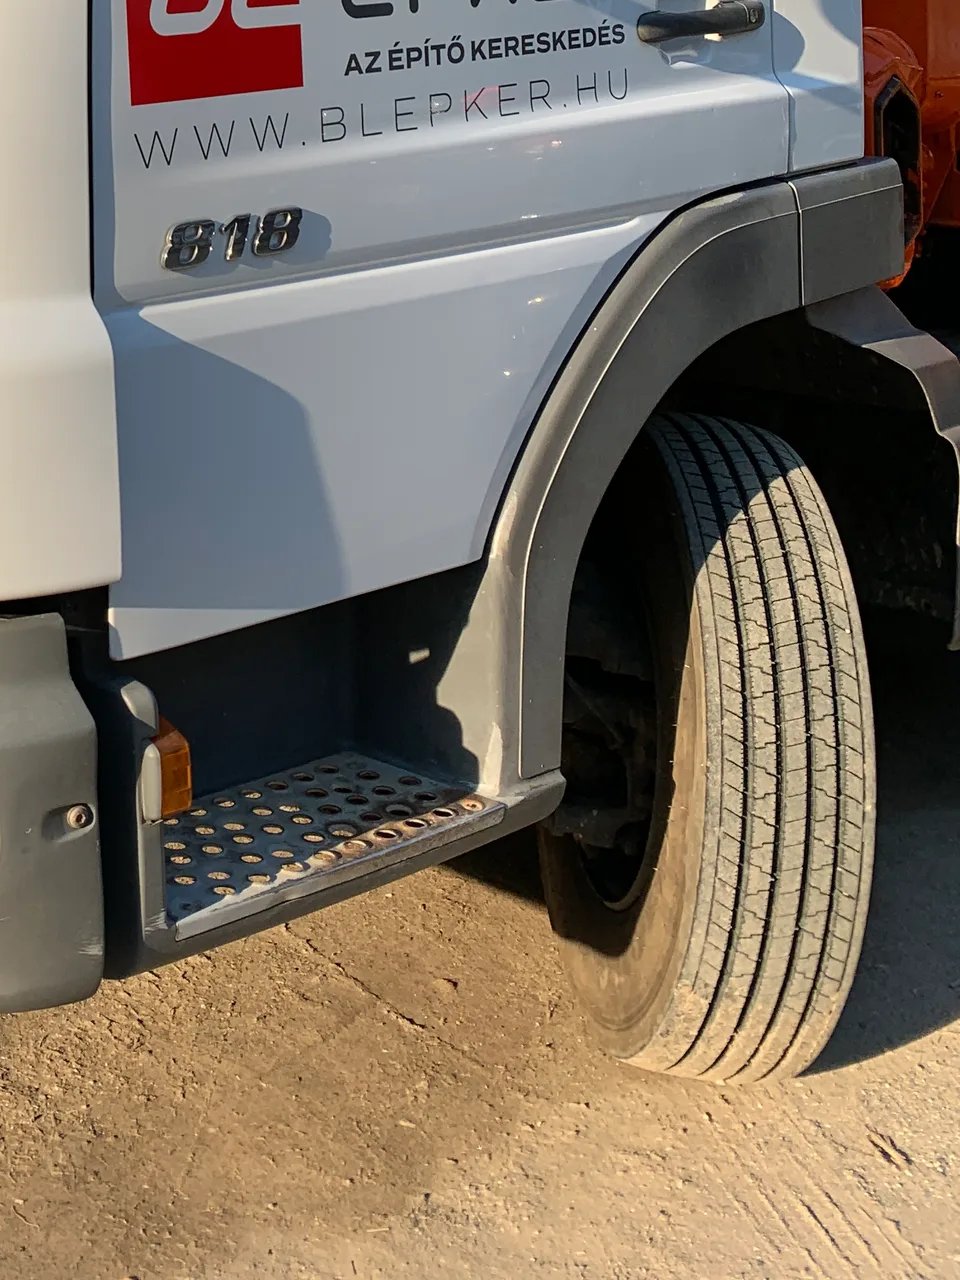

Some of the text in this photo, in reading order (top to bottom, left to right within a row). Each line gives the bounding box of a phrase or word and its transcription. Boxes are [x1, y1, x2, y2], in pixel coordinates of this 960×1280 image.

[344, 20, 626, 77] AZ ÉPÍTŐ KERESKEDÉS
[134, 67, 629, 169] WWW.BLEPKER.HU
[161, 206, 303, 272] 818
